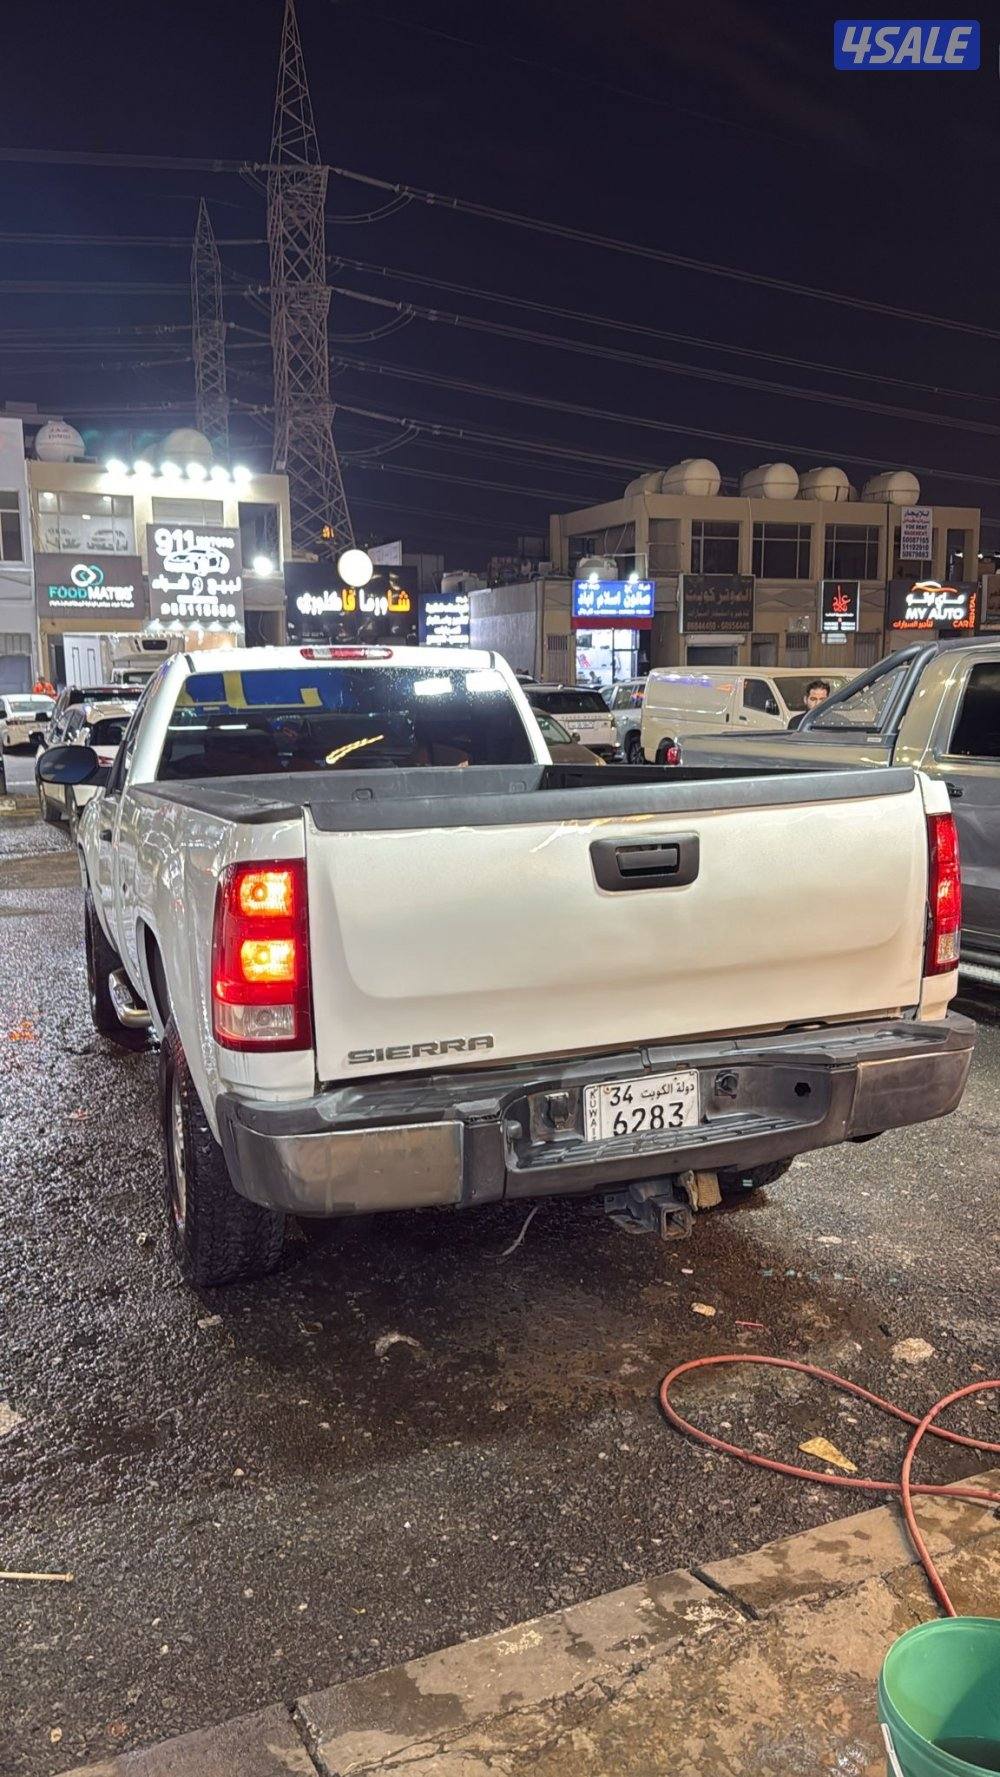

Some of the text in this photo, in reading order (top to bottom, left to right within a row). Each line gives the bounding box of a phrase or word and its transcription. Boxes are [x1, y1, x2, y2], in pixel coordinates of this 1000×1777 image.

[154, 528, 195, 556] 911
[48, 585, 87, 599] FOOD
[358, 588, 411, 616] شاورما
[905, 607, 965, 620] MY AUTO
[968, 592, 977, 628] RENTAL
[952, 620, 969, 628] CAR
[347, 1032, 495, 1065] SIERRA
[609, 1084, 634, 1106] 34
[640, 1081, 695, 1101] دولة الكويت
[612, 1101, 684, 1137] 6283
